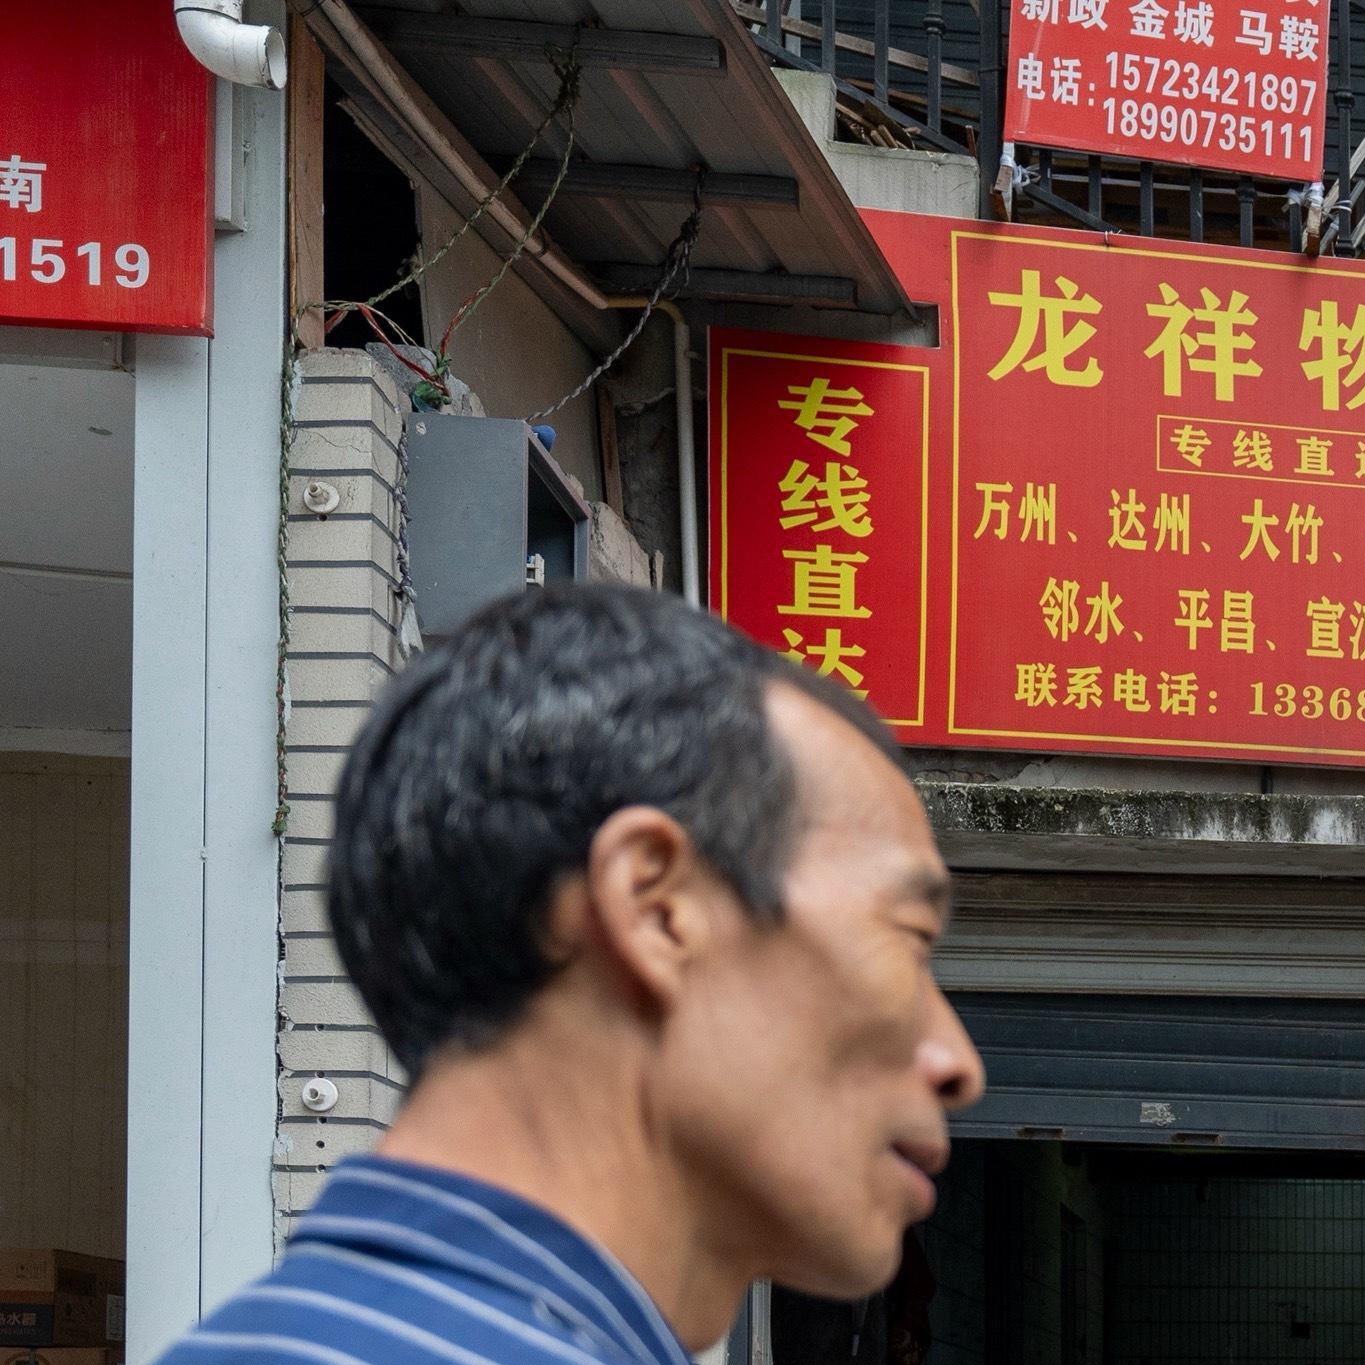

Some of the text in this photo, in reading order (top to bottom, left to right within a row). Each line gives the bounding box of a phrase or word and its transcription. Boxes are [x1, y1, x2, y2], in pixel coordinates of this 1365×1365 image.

[1128, 0, 1215, 48] 金城
[1234, 9, 1320, 62] 马鞍
[1105, 51, 1317, 116] 15723421897
[1103, 97, 1312, 162] 18990735111
[0, 154, 47, 213] 南
